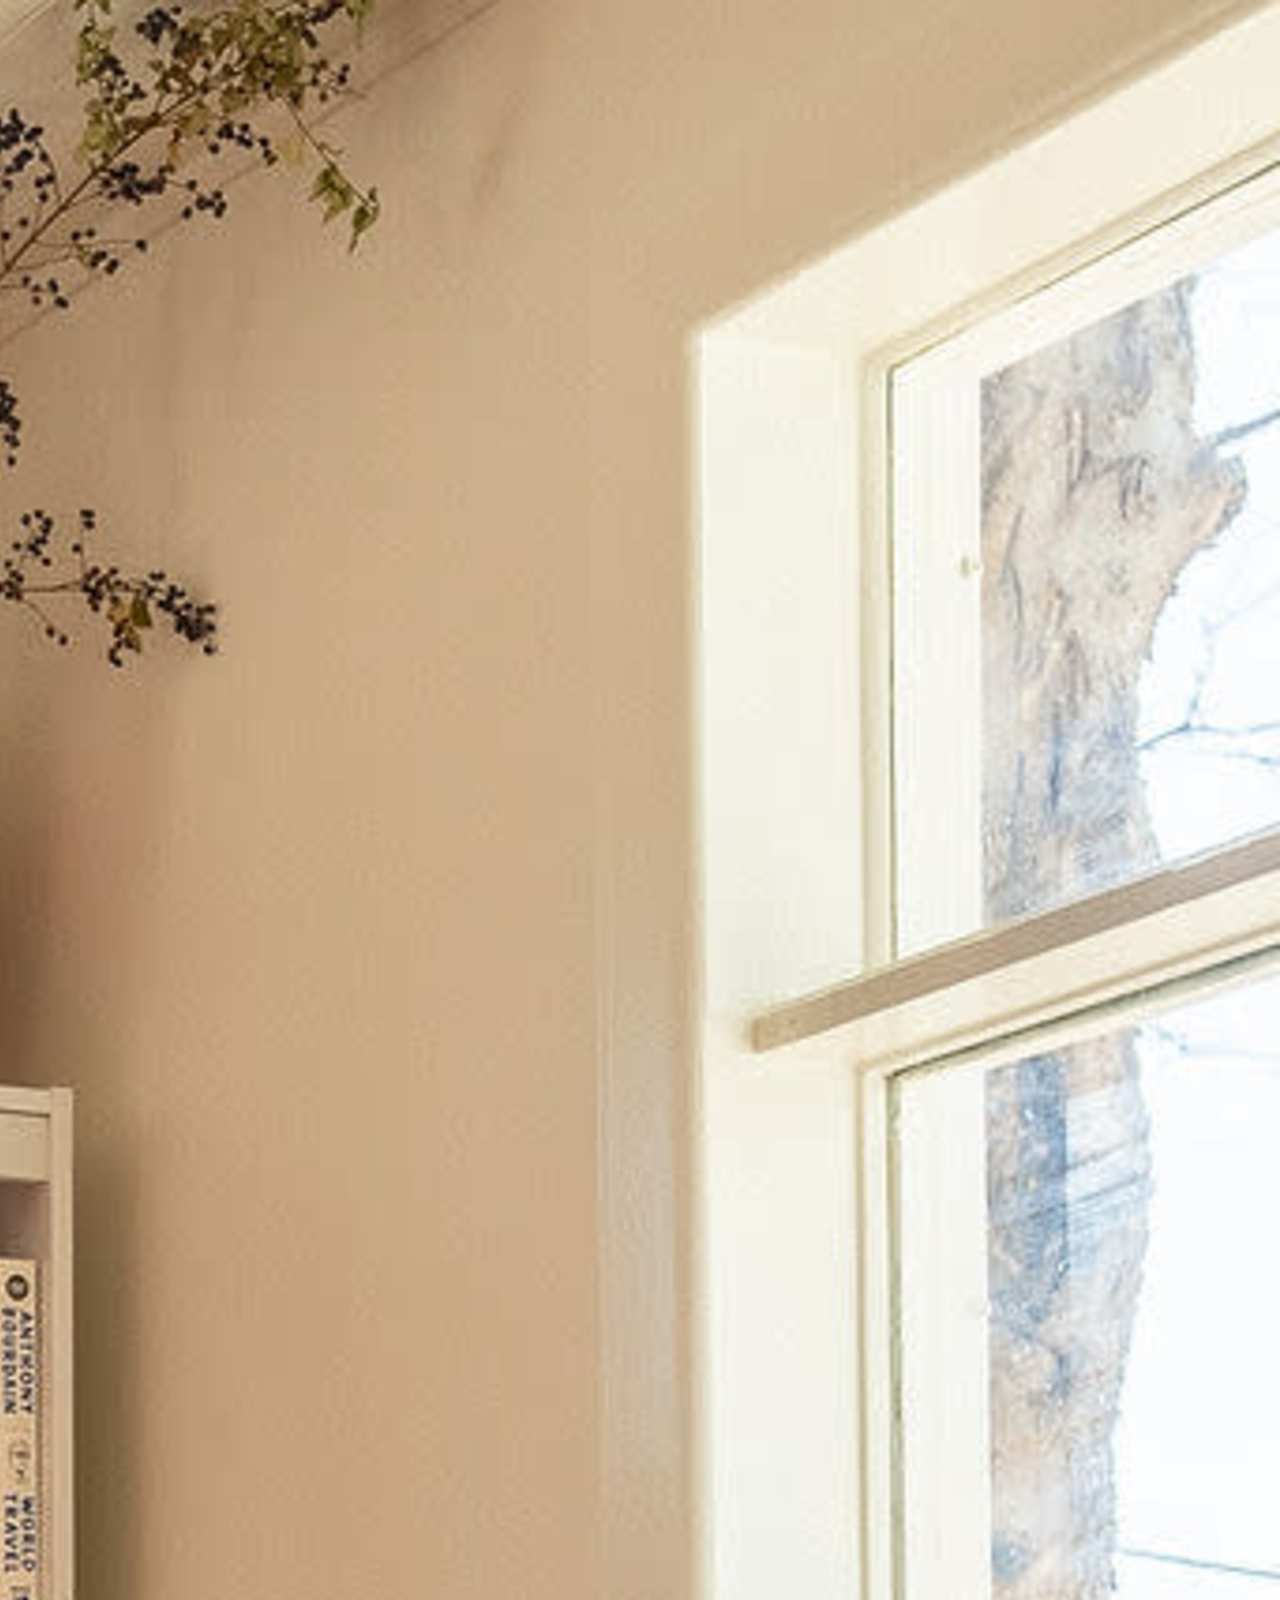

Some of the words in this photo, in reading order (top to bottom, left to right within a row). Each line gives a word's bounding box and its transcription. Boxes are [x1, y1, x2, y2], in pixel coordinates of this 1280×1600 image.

[2, 1307, 19, 1416] BOURDAIN
[19, 1310, 36, 1415] ANTHONY
[3, 1493, 19, 1573] TRAVEL
[20, 1495, 37, 1573] WORLD
